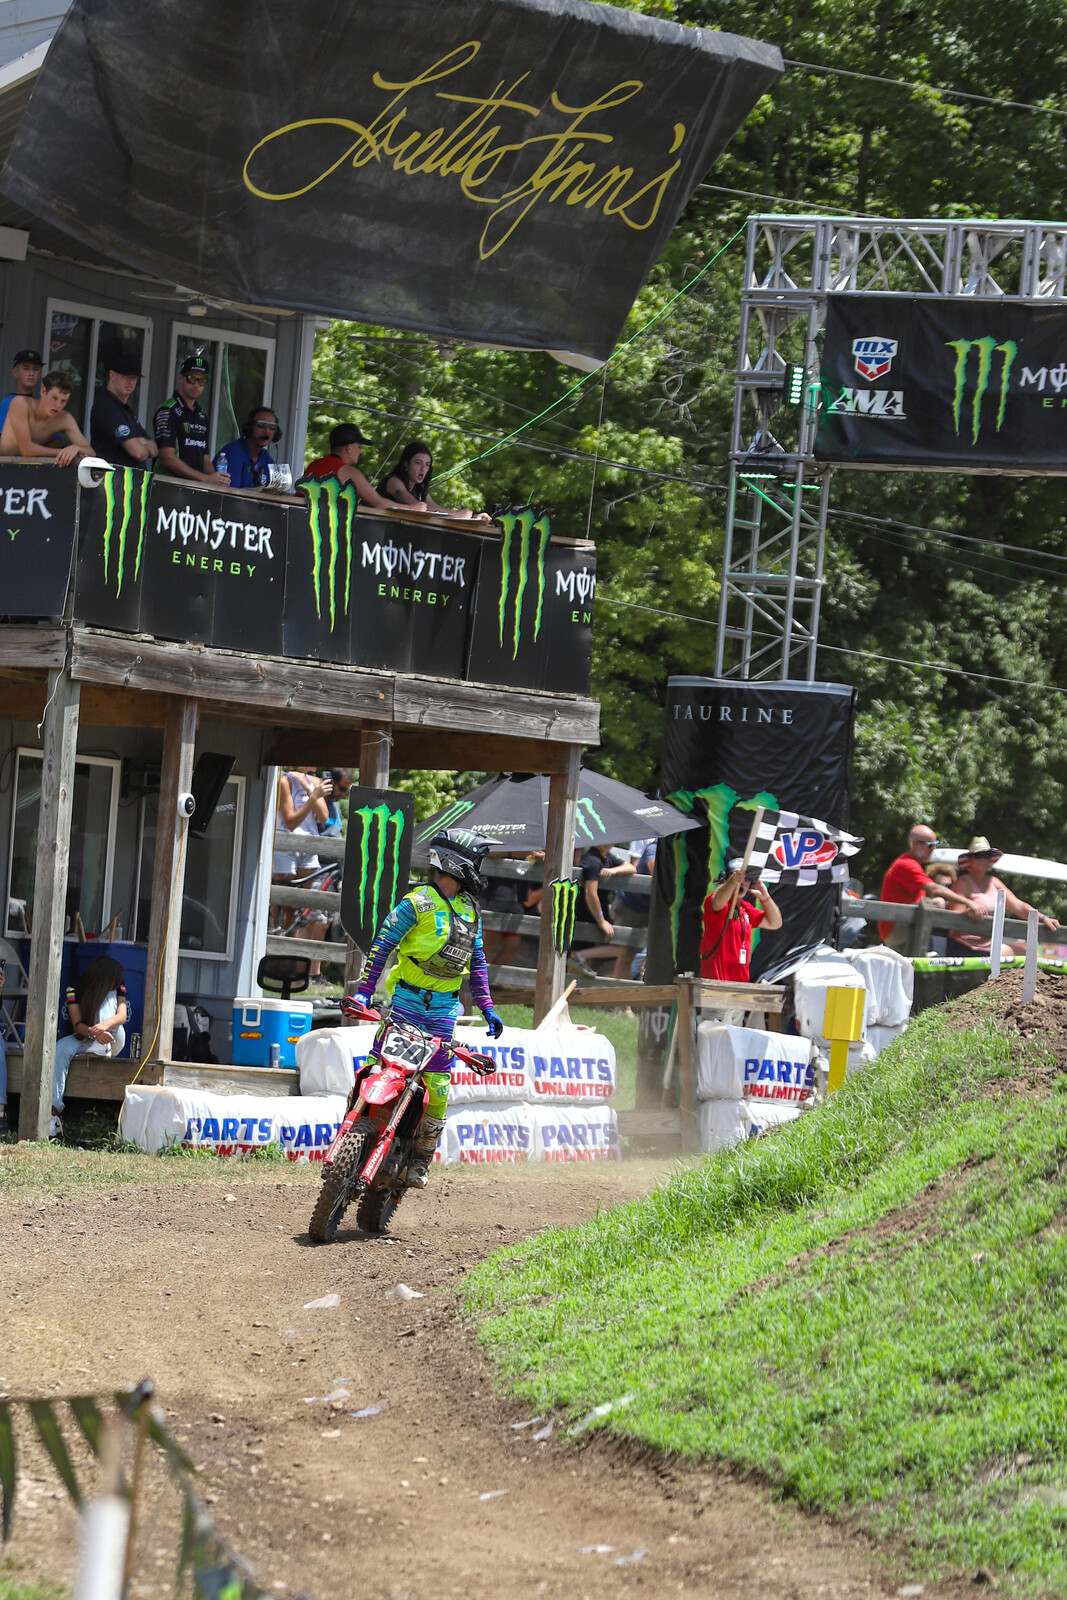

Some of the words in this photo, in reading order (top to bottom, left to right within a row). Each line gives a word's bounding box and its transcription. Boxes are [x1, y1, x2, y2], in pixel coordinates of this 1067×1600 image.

[827, 388, 907, 415] AMA
[156, 505, 274, 560] MONSTER
[172, 550, 256, 577] ENERGY
[361, 539, 466, 588] MONSTER
[378, 583, 450, 606] ENERGY
[673, 704, 794, 724] TAURINE
[471, 823, 527, 831] MONSTER
[781, 831, 824, 867] VP
[383, 1036, 431, 1065] 30
[450, 1072, 525, 1087] UNLIMITED
[533, 1056, 612, 1081] PARTS
[744, 1059, 816, 1087] PARTS
[534, 1081, 614, 1098] UNLIMITED
[184, 1118, 272, 1141] PARTS
[456, 1124, 530, 1148] PARTS
[541, 1123, 617, 1147] PARTS
